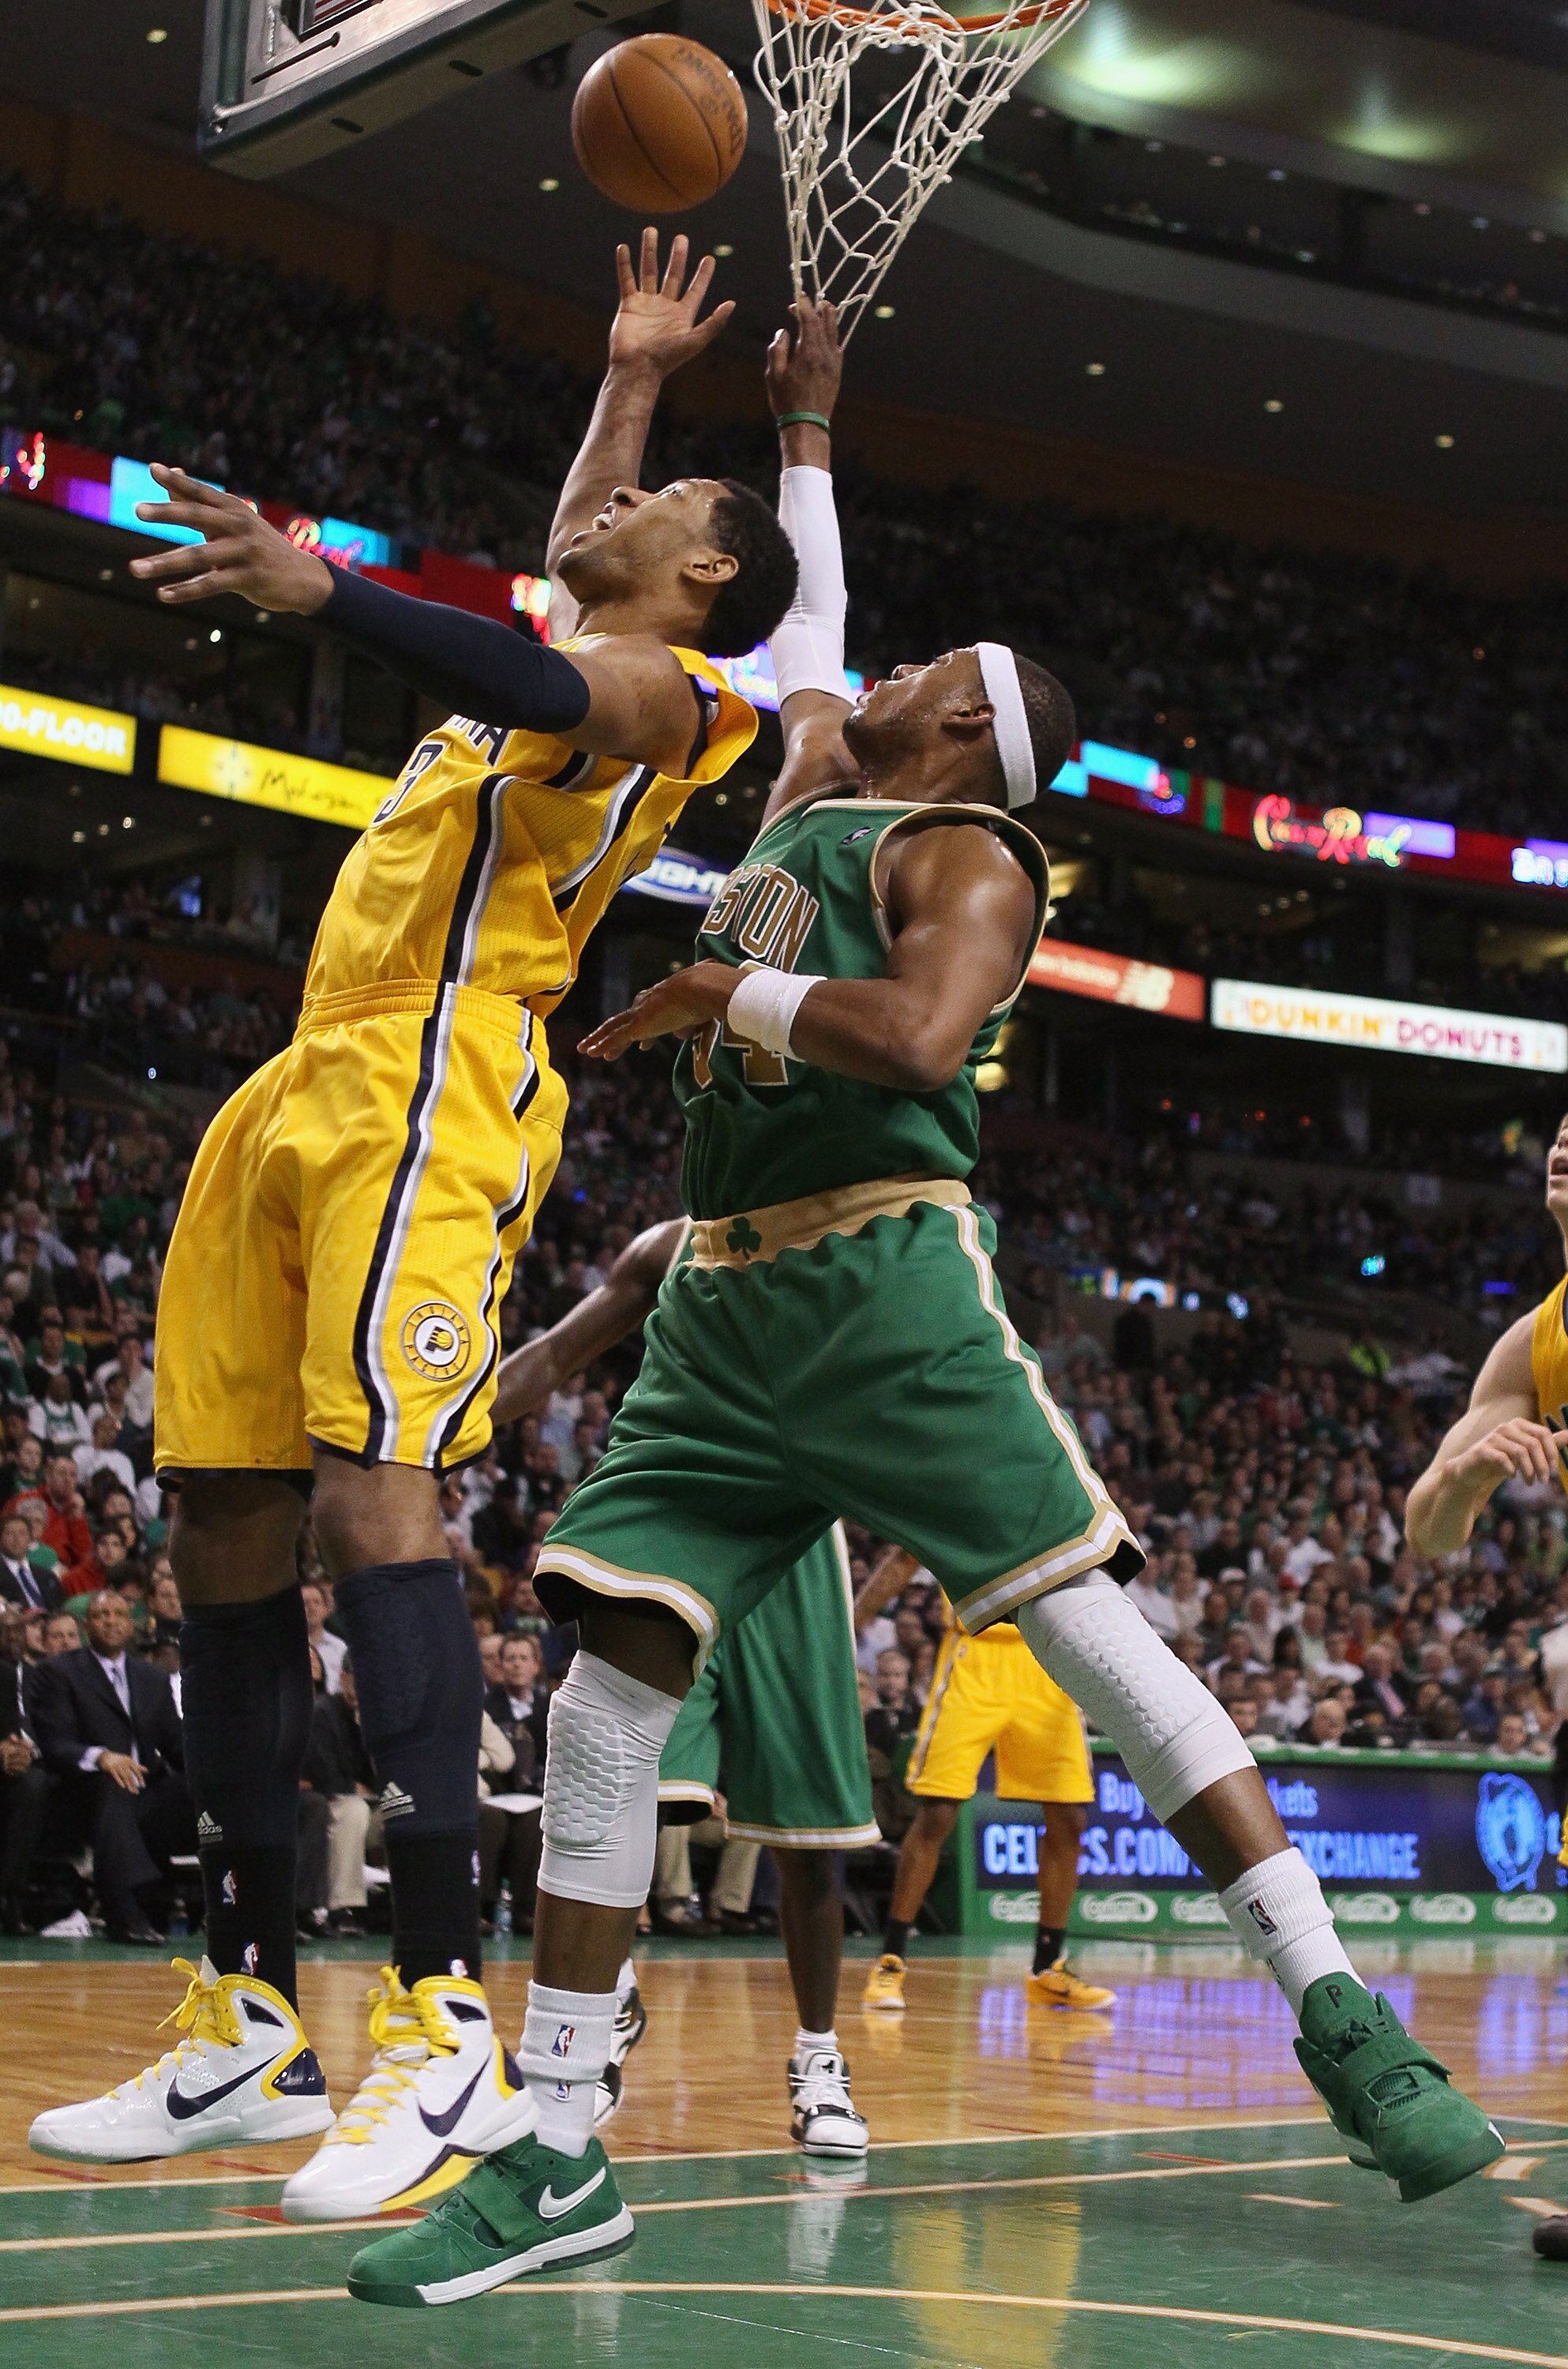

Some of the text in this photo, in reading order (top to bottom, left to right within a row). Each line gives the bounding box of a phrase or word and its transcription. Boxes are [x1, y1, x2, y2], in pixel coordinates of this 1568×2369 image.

[0, 698, 126, 758] O-FLOOR
[1397, 1016, 1522, 1059] DONUTS
[1099, 1771, 1144, 1822] Buy
